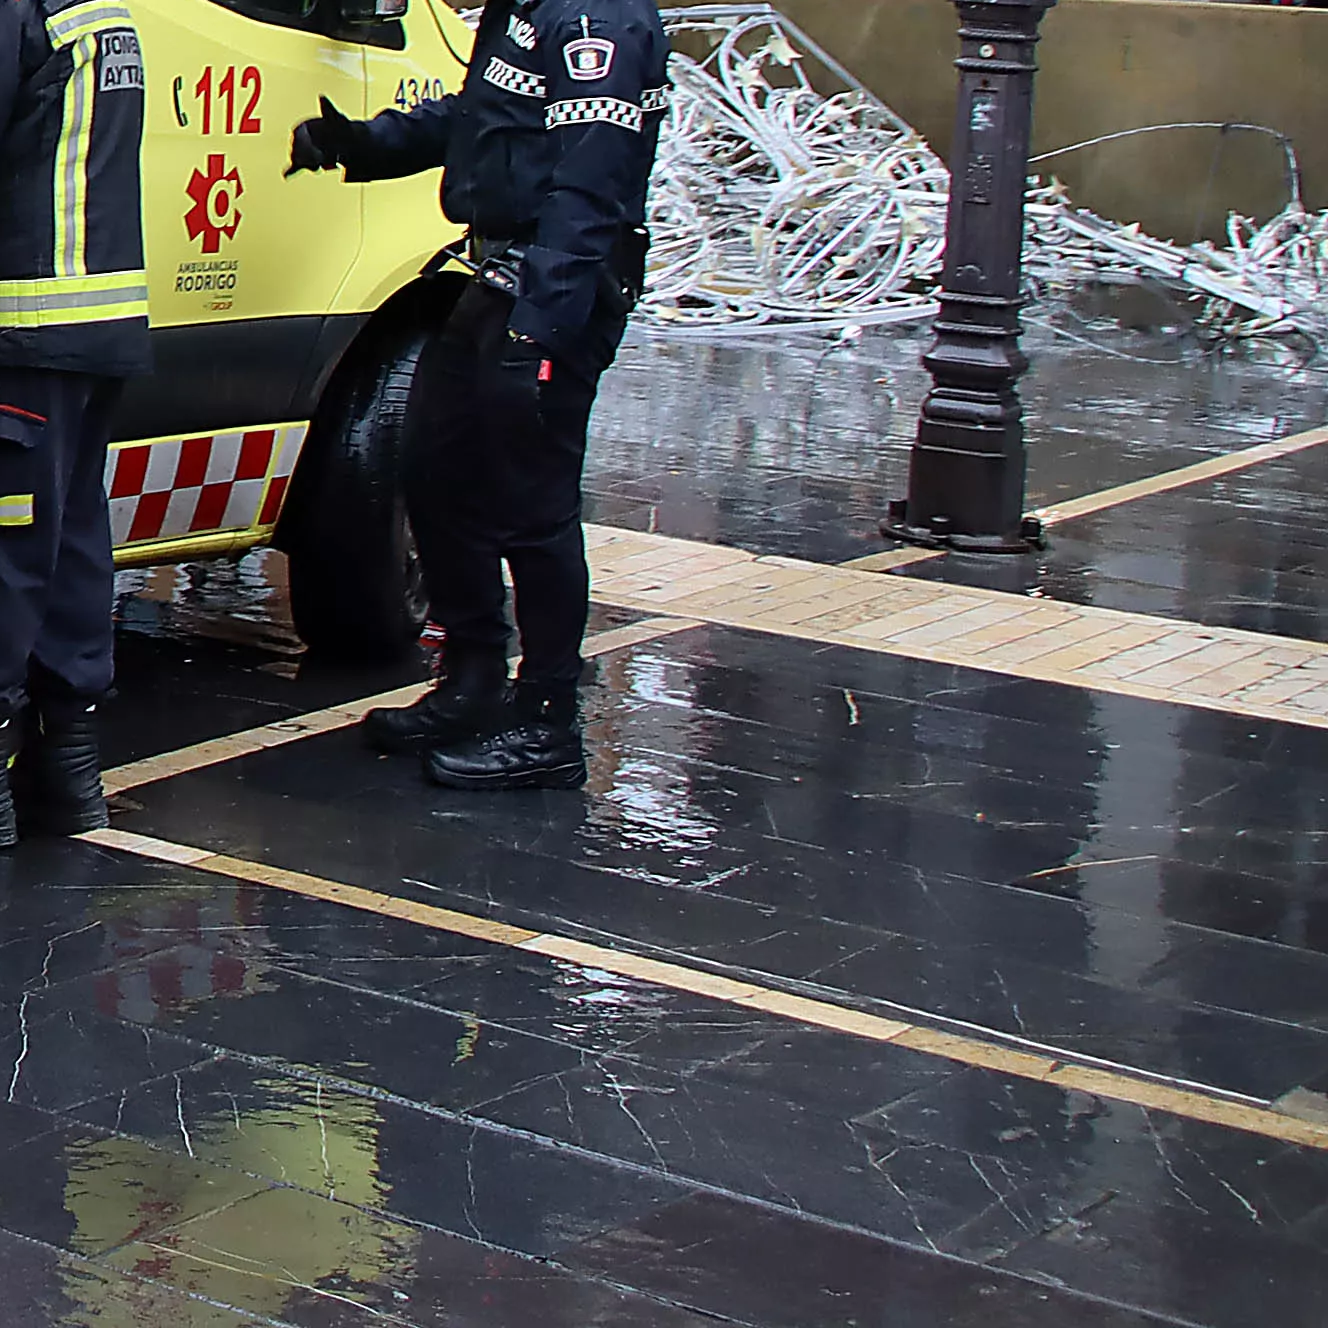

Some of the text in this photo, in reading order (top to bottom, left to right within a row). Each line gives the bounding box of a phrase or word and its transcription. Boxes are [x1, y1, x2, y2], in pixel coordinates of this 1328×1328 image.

[194, 65, 262, 135] 112
[177, 259, 239, 274] AMBULANCIAS
[175, 273, 237, 293] RODRIGO
